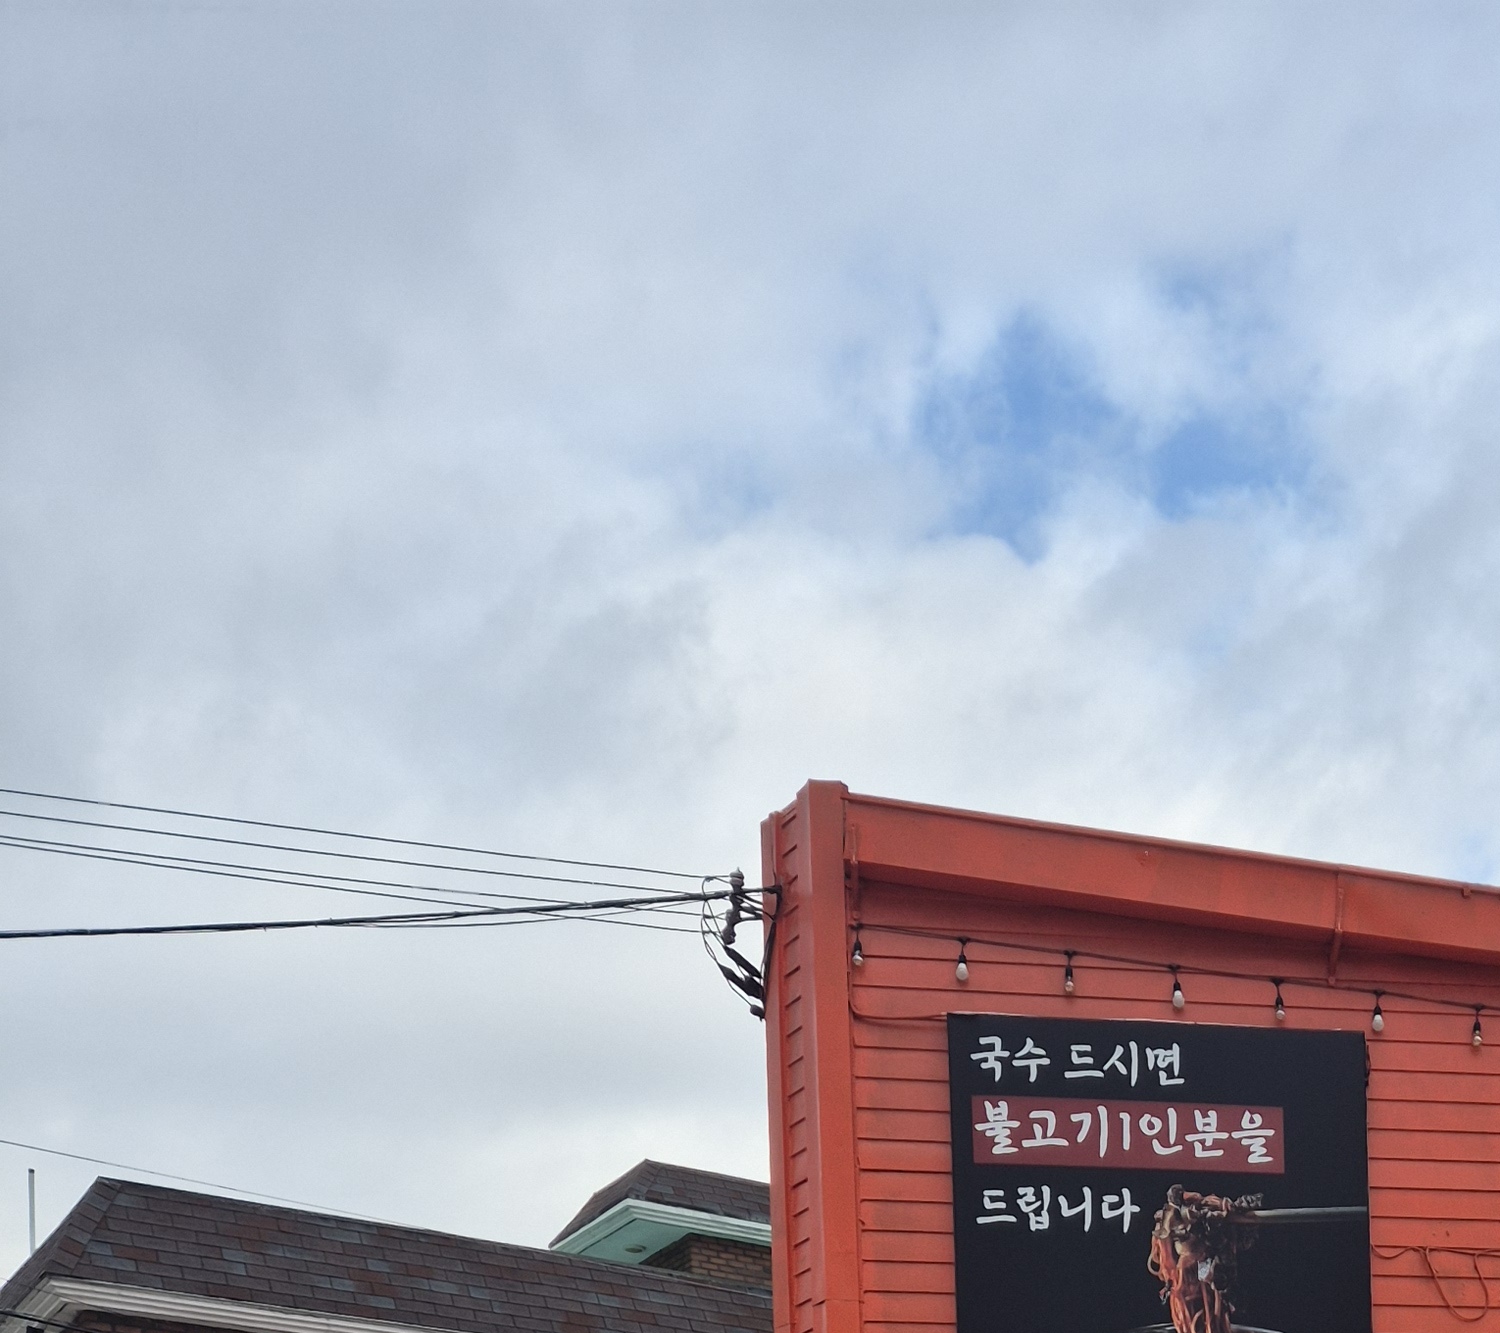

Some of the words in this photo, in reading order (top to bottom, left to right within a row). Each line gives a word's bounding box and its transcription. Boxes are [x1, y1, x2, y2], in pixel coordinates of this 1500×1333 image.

[970, 1036, 1051, 1083] 국수
[1064, 1041, 1185, 1087] 드시면
[974, 1101, 1276, 1163] 불고기1인분을
[976, 1185, 1140, 1234] 드립니다
